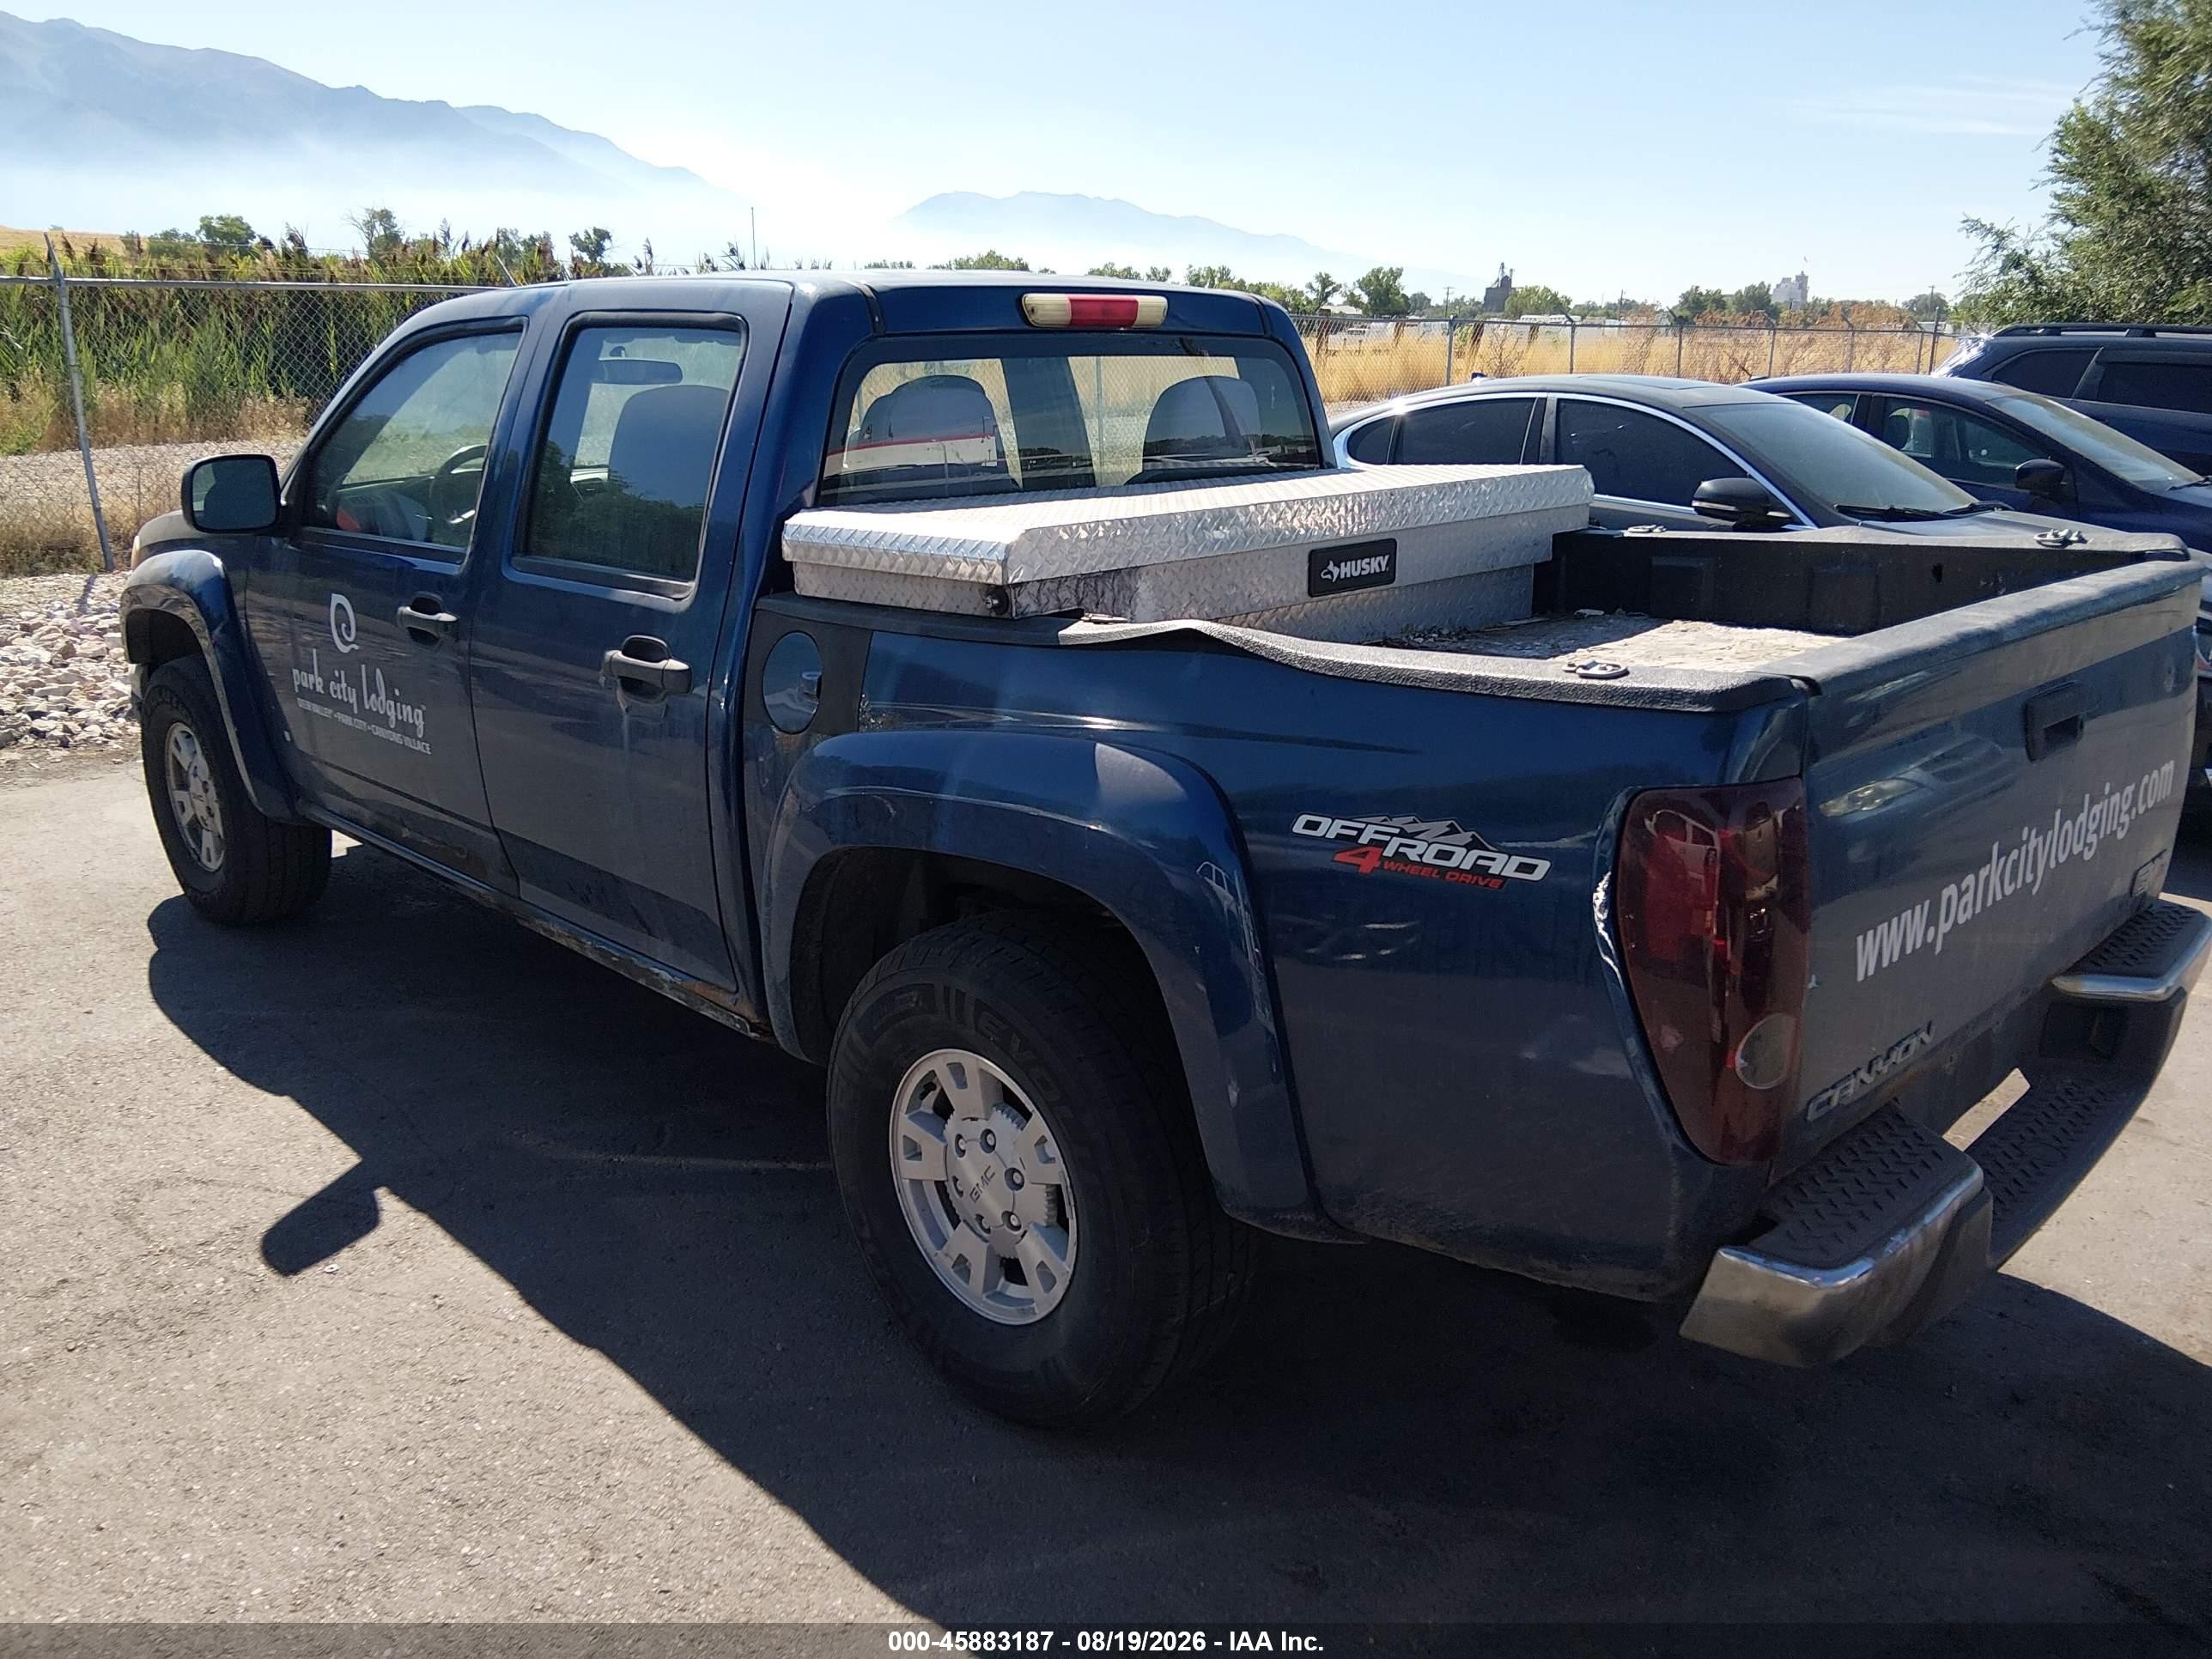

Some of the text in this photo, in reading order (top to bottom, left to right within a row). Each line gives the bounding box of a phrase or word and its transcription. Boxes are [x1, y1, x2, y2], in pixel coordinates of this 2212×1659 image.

[1340, 555, 1389, 579] HUSKY
[292, 648, 425, 738] park city lodging
[1333, 845, 1504, 890] 4 WHEEL DRIVE
[1855, 760, 2175, 982] www.parkcitylodging.com
[1807, 1020, 1936, 1121] CANYON
[969, 1165, 995, 1202] GMC
